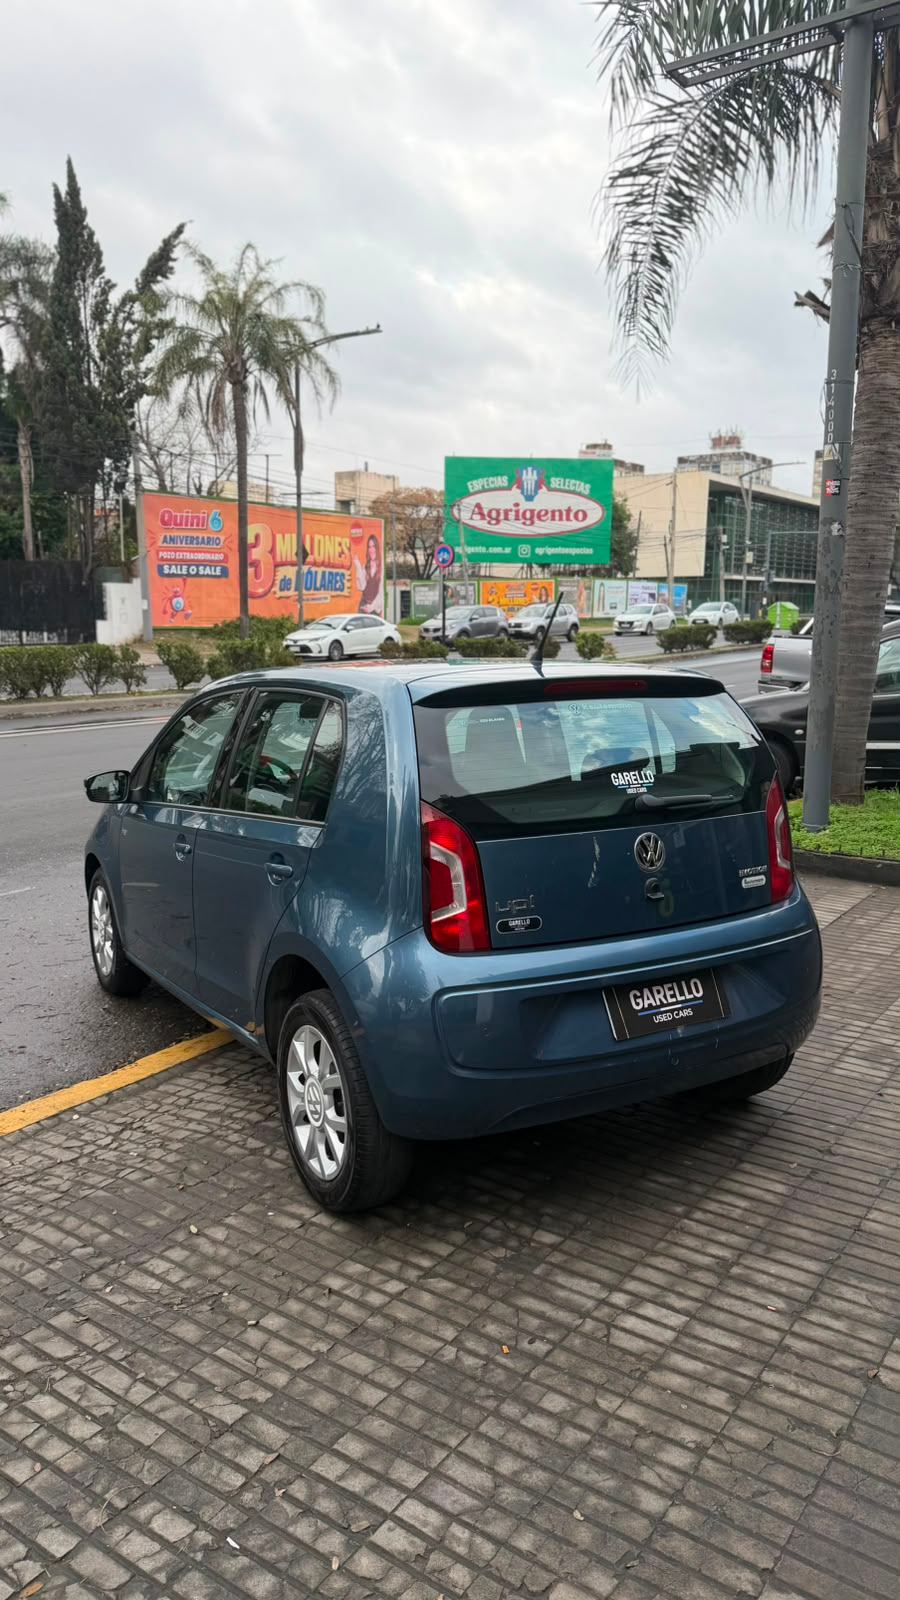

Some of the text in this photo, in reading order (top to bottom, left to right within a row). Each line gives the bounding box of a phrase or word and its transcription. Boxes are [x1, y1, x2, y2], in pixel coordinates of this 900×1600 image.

[467, 475, 592, 495] ESPECIAS SELECTAS
[160, 508, 224, 532] Quini 6
[470, 502, 588, 527] Agrigento
[162, 534, 221, 547] ANIVERSARIO
[163, 564, 222, 576] SALE O SALE
[248, 523, 275, 598] 3
[279, 574, 292, 592] de
[610, 770, 655, 786] GARELLO
[628, 977, 704, 1011] GARELLO
[653, 1007, 694, 1023] USED CARS
